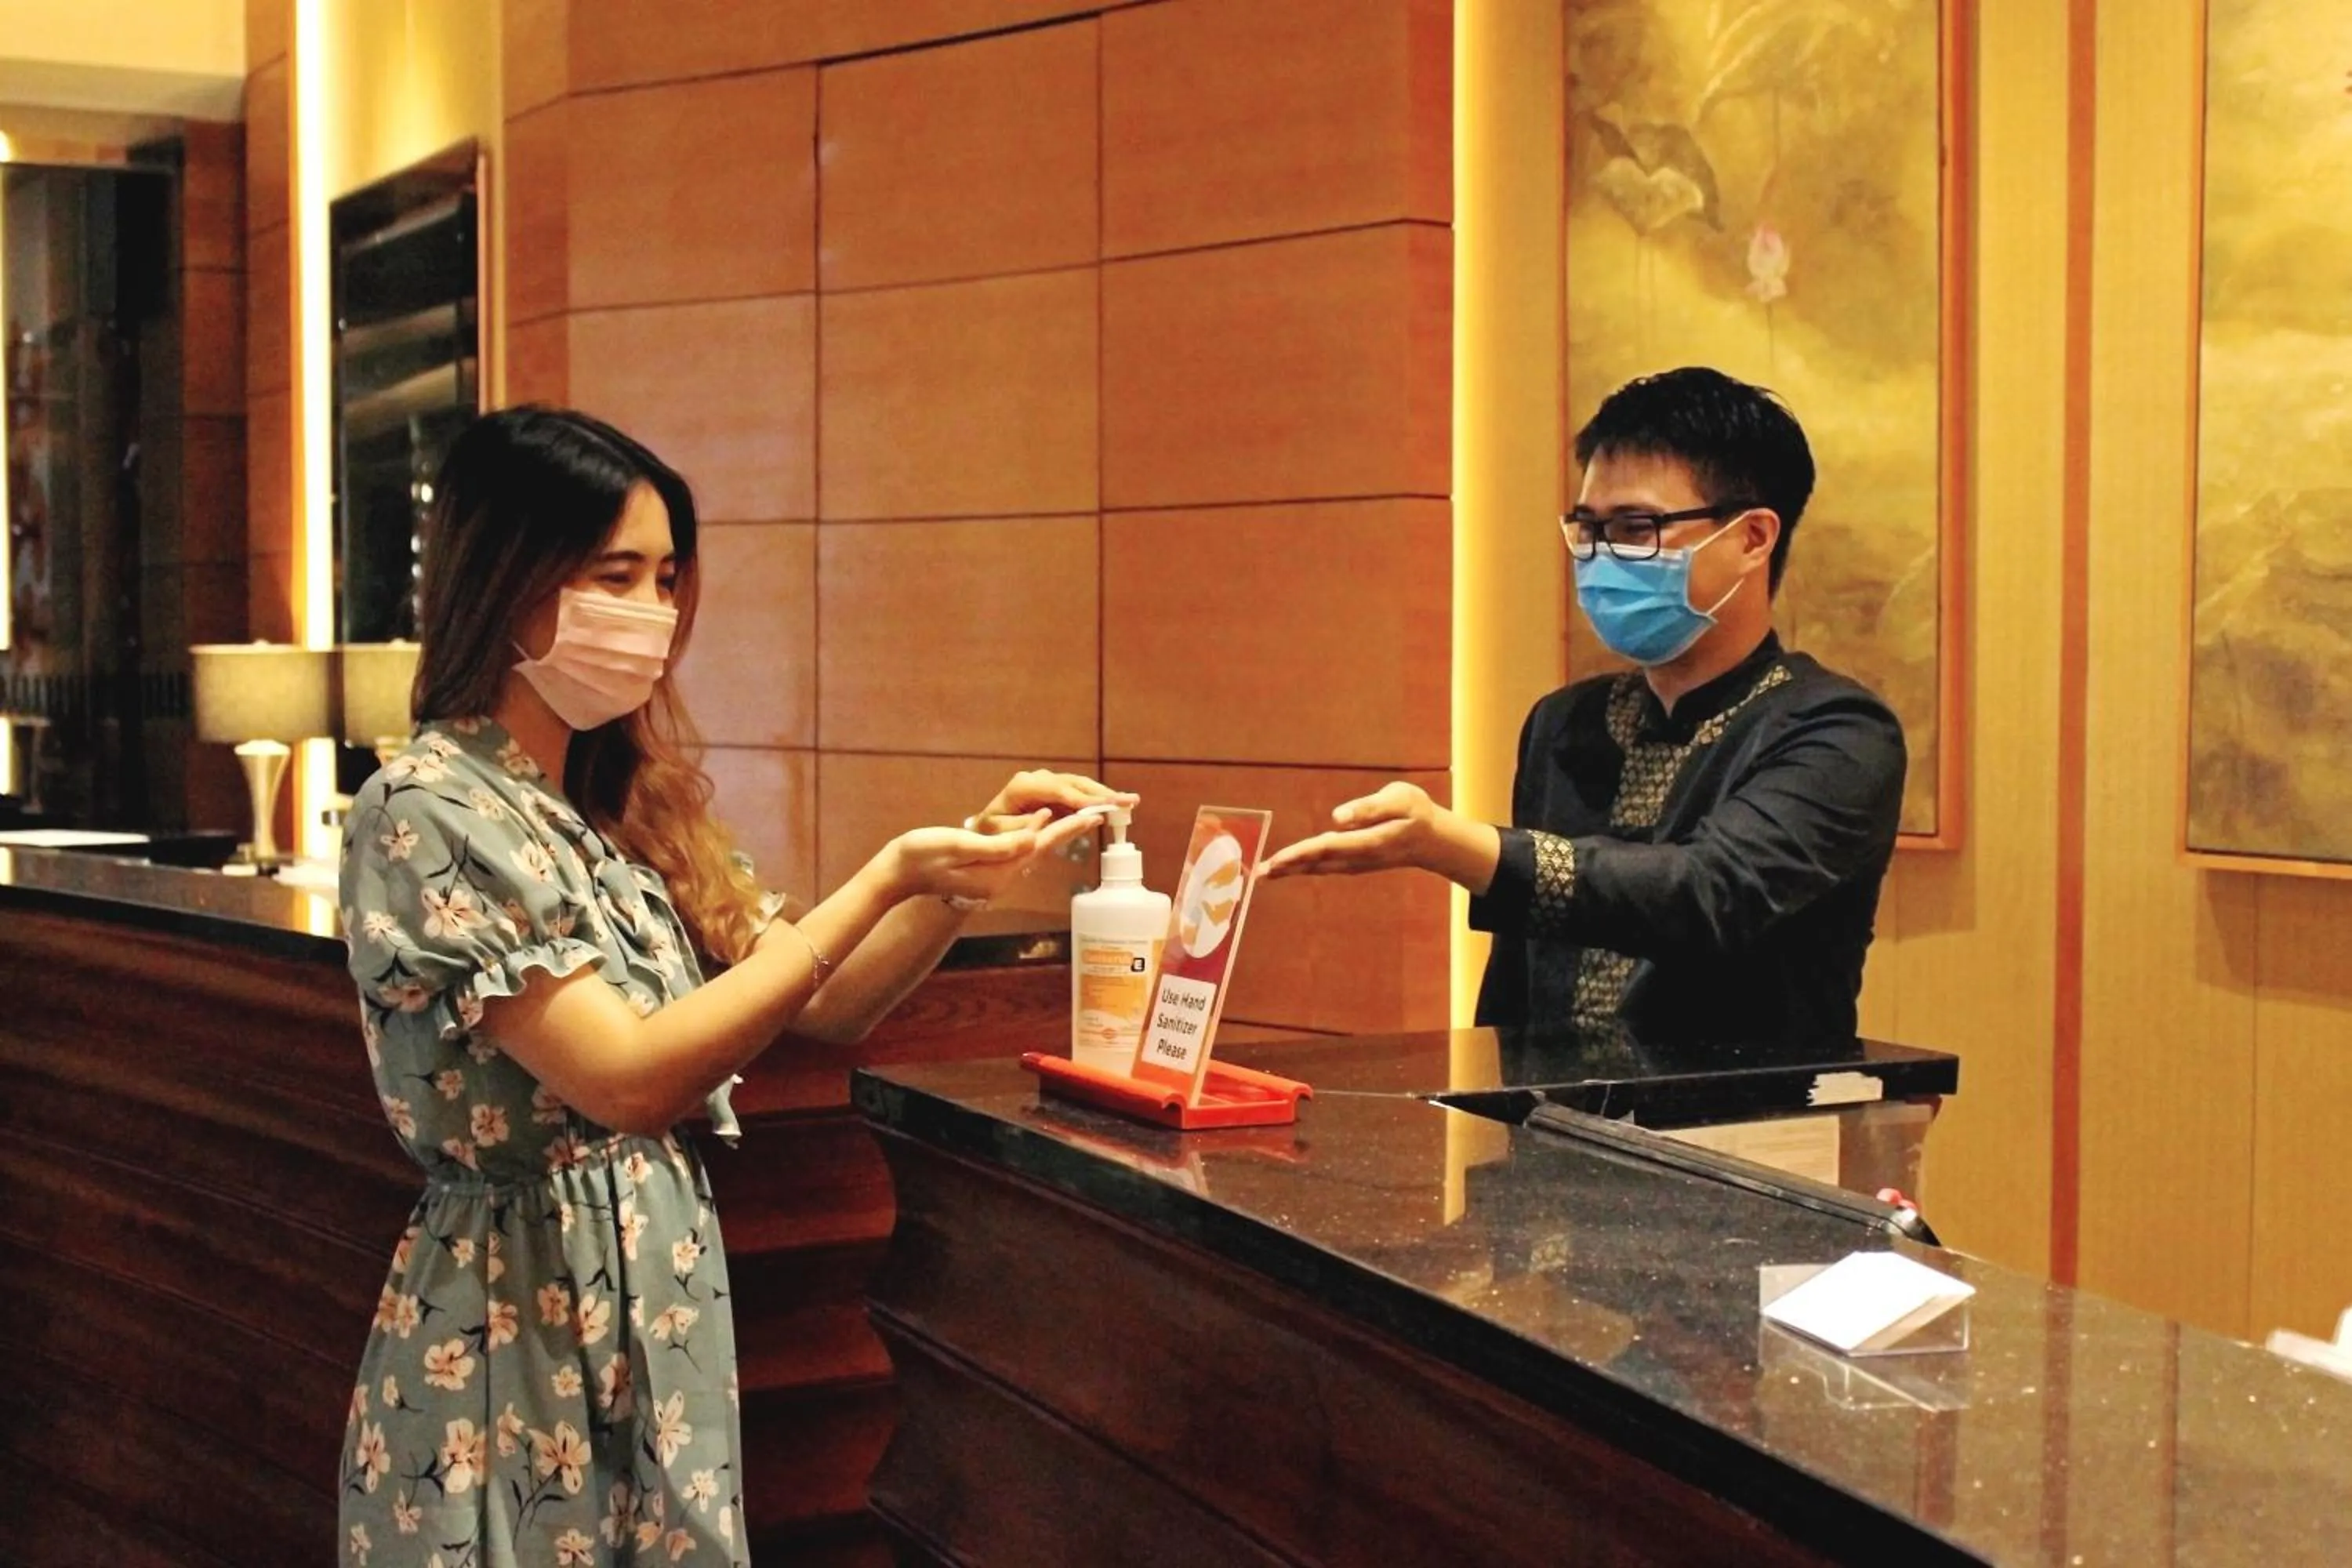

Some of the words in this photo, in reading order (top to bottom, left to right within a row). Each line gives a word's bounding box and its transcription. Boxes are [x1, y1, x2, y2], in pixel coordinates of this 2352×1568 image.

[1161, 988, 1179, 1006] Use
[1181, 993, 1207, 1011] Hand
[1156, 1012, 1199, 1035] Sanitizer
[1156, 1039, 1188, 1060] Please
